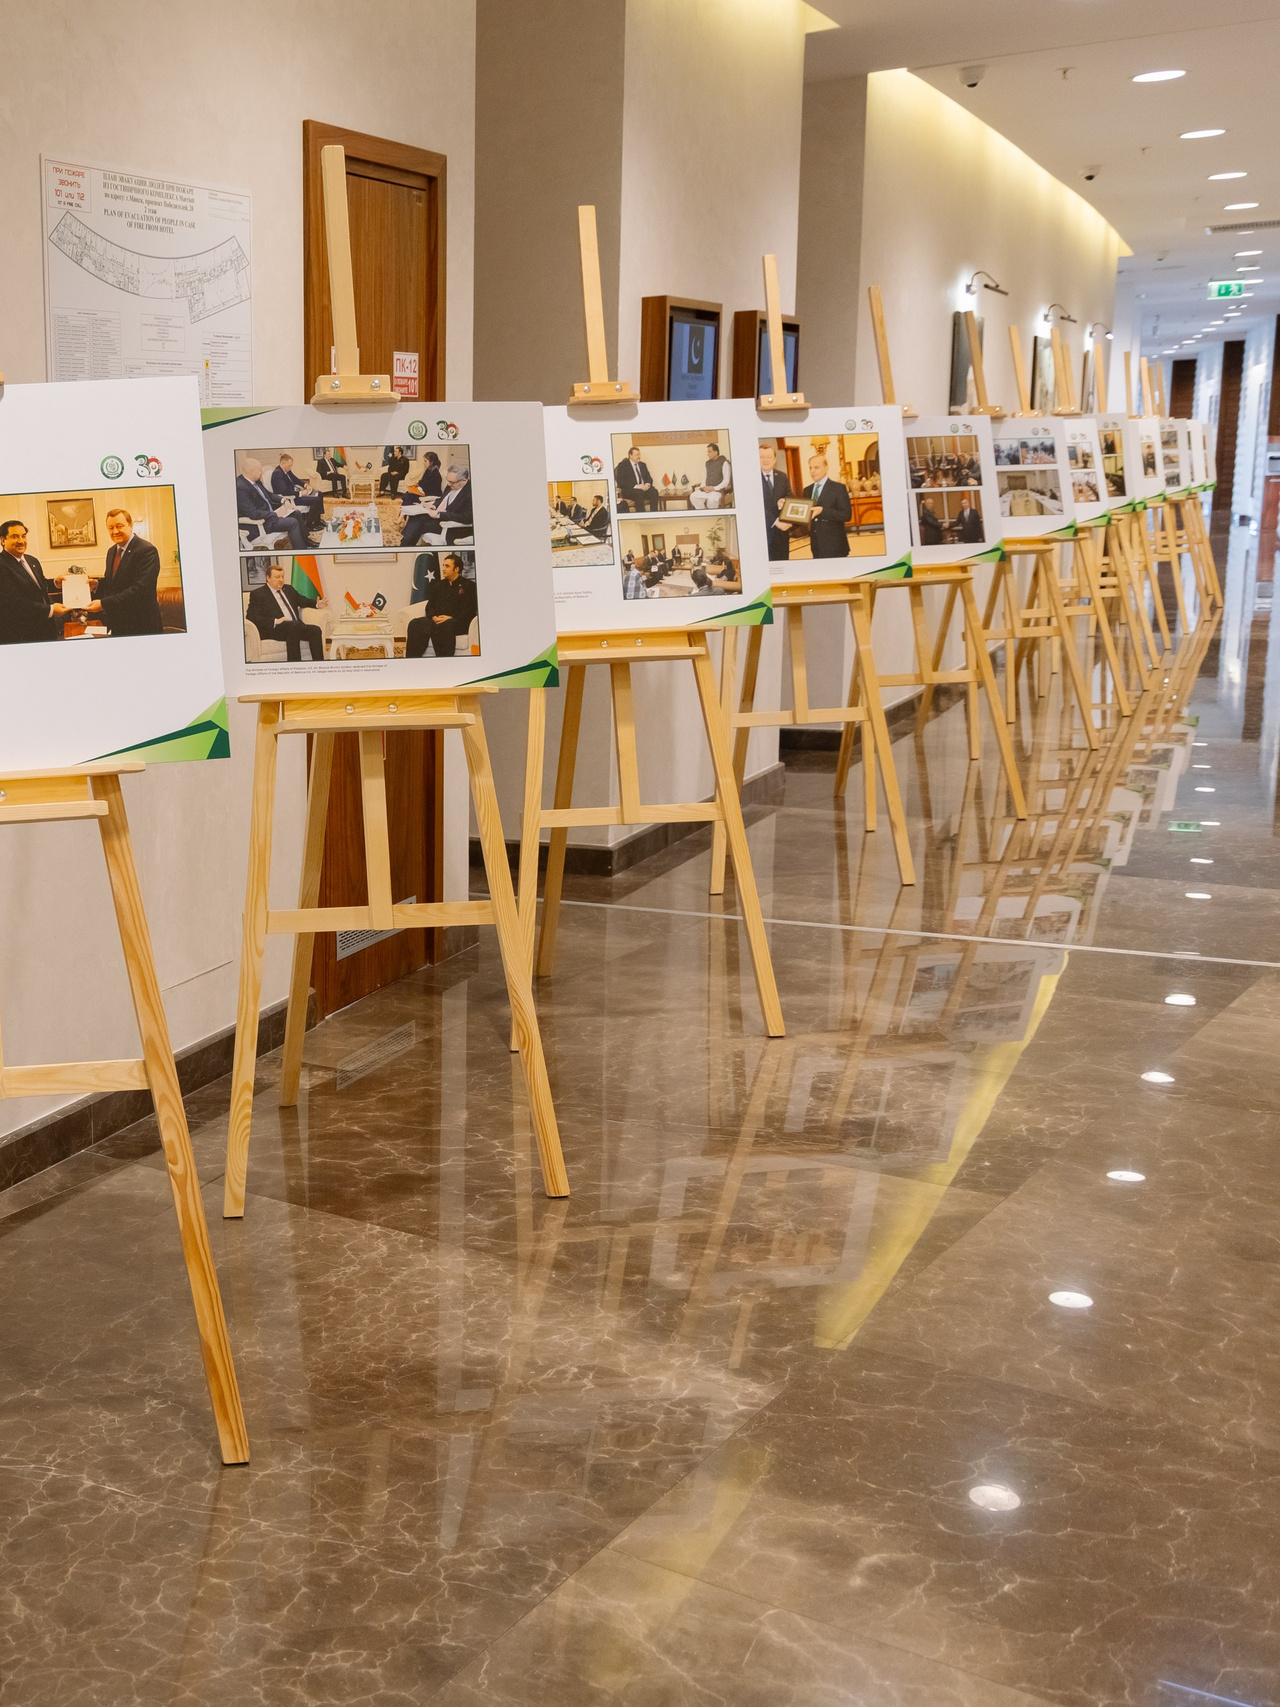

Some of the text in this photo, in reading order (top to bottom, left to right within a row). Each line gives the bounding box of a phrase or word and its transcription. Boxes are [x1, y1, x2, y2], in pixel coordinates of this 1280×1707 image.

[103, 208, 118, 218] PLAN
[124, 211, 155, 222] EVACUATION
[161, 217, 178, 226] PEOPLE
[133, 222, 145, 230] FIRE
[145, 223, 159, 232] FROM
[159, 225, 175, 234] HOTEL
[396, 358, 417, 373] ПК-12
[408, 380, 417, 393] 101
